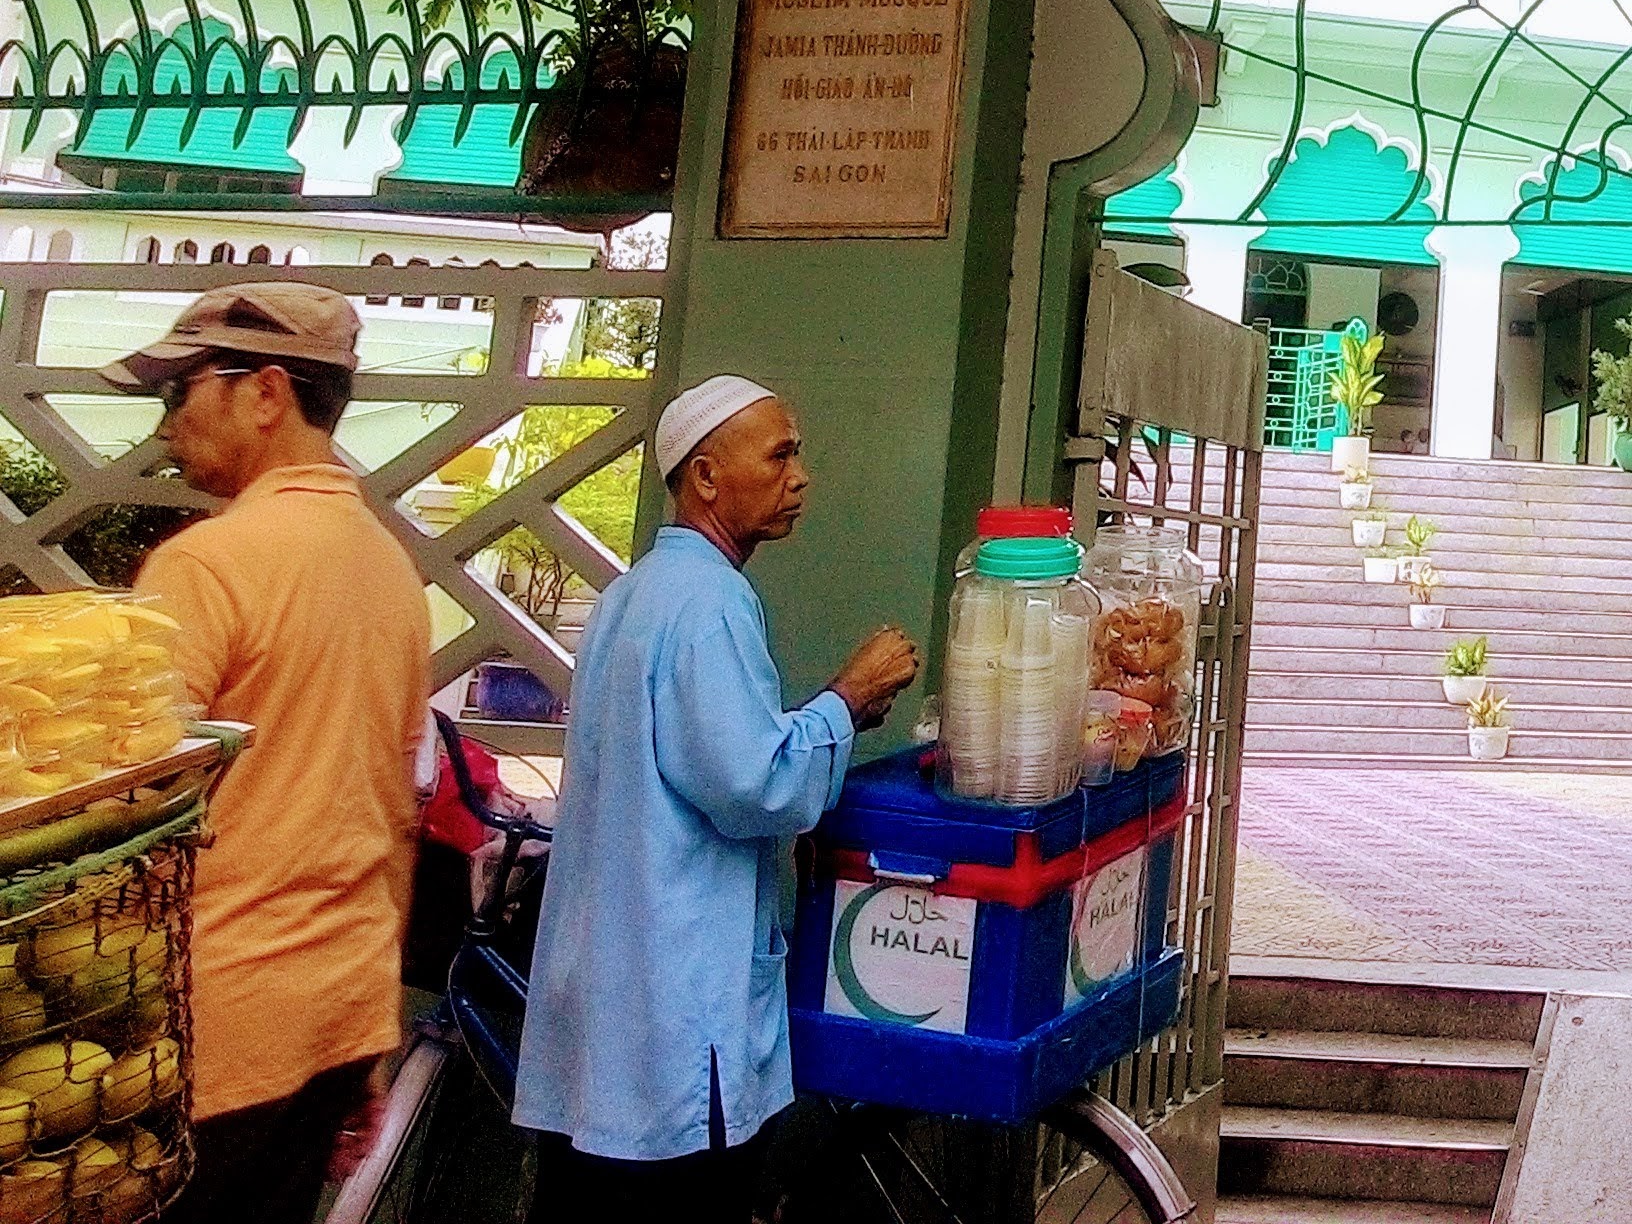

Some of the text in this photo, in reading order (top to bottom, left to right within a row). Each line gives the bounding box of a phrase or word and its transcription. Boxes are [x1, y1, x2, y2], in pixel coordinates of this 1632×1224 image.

[763, 35, 816, 58] JAMIA
[757, 131, 778, 151] 66
[890, 894, 948, 925] حلال
[870, 925, 969, 961] HALAL
